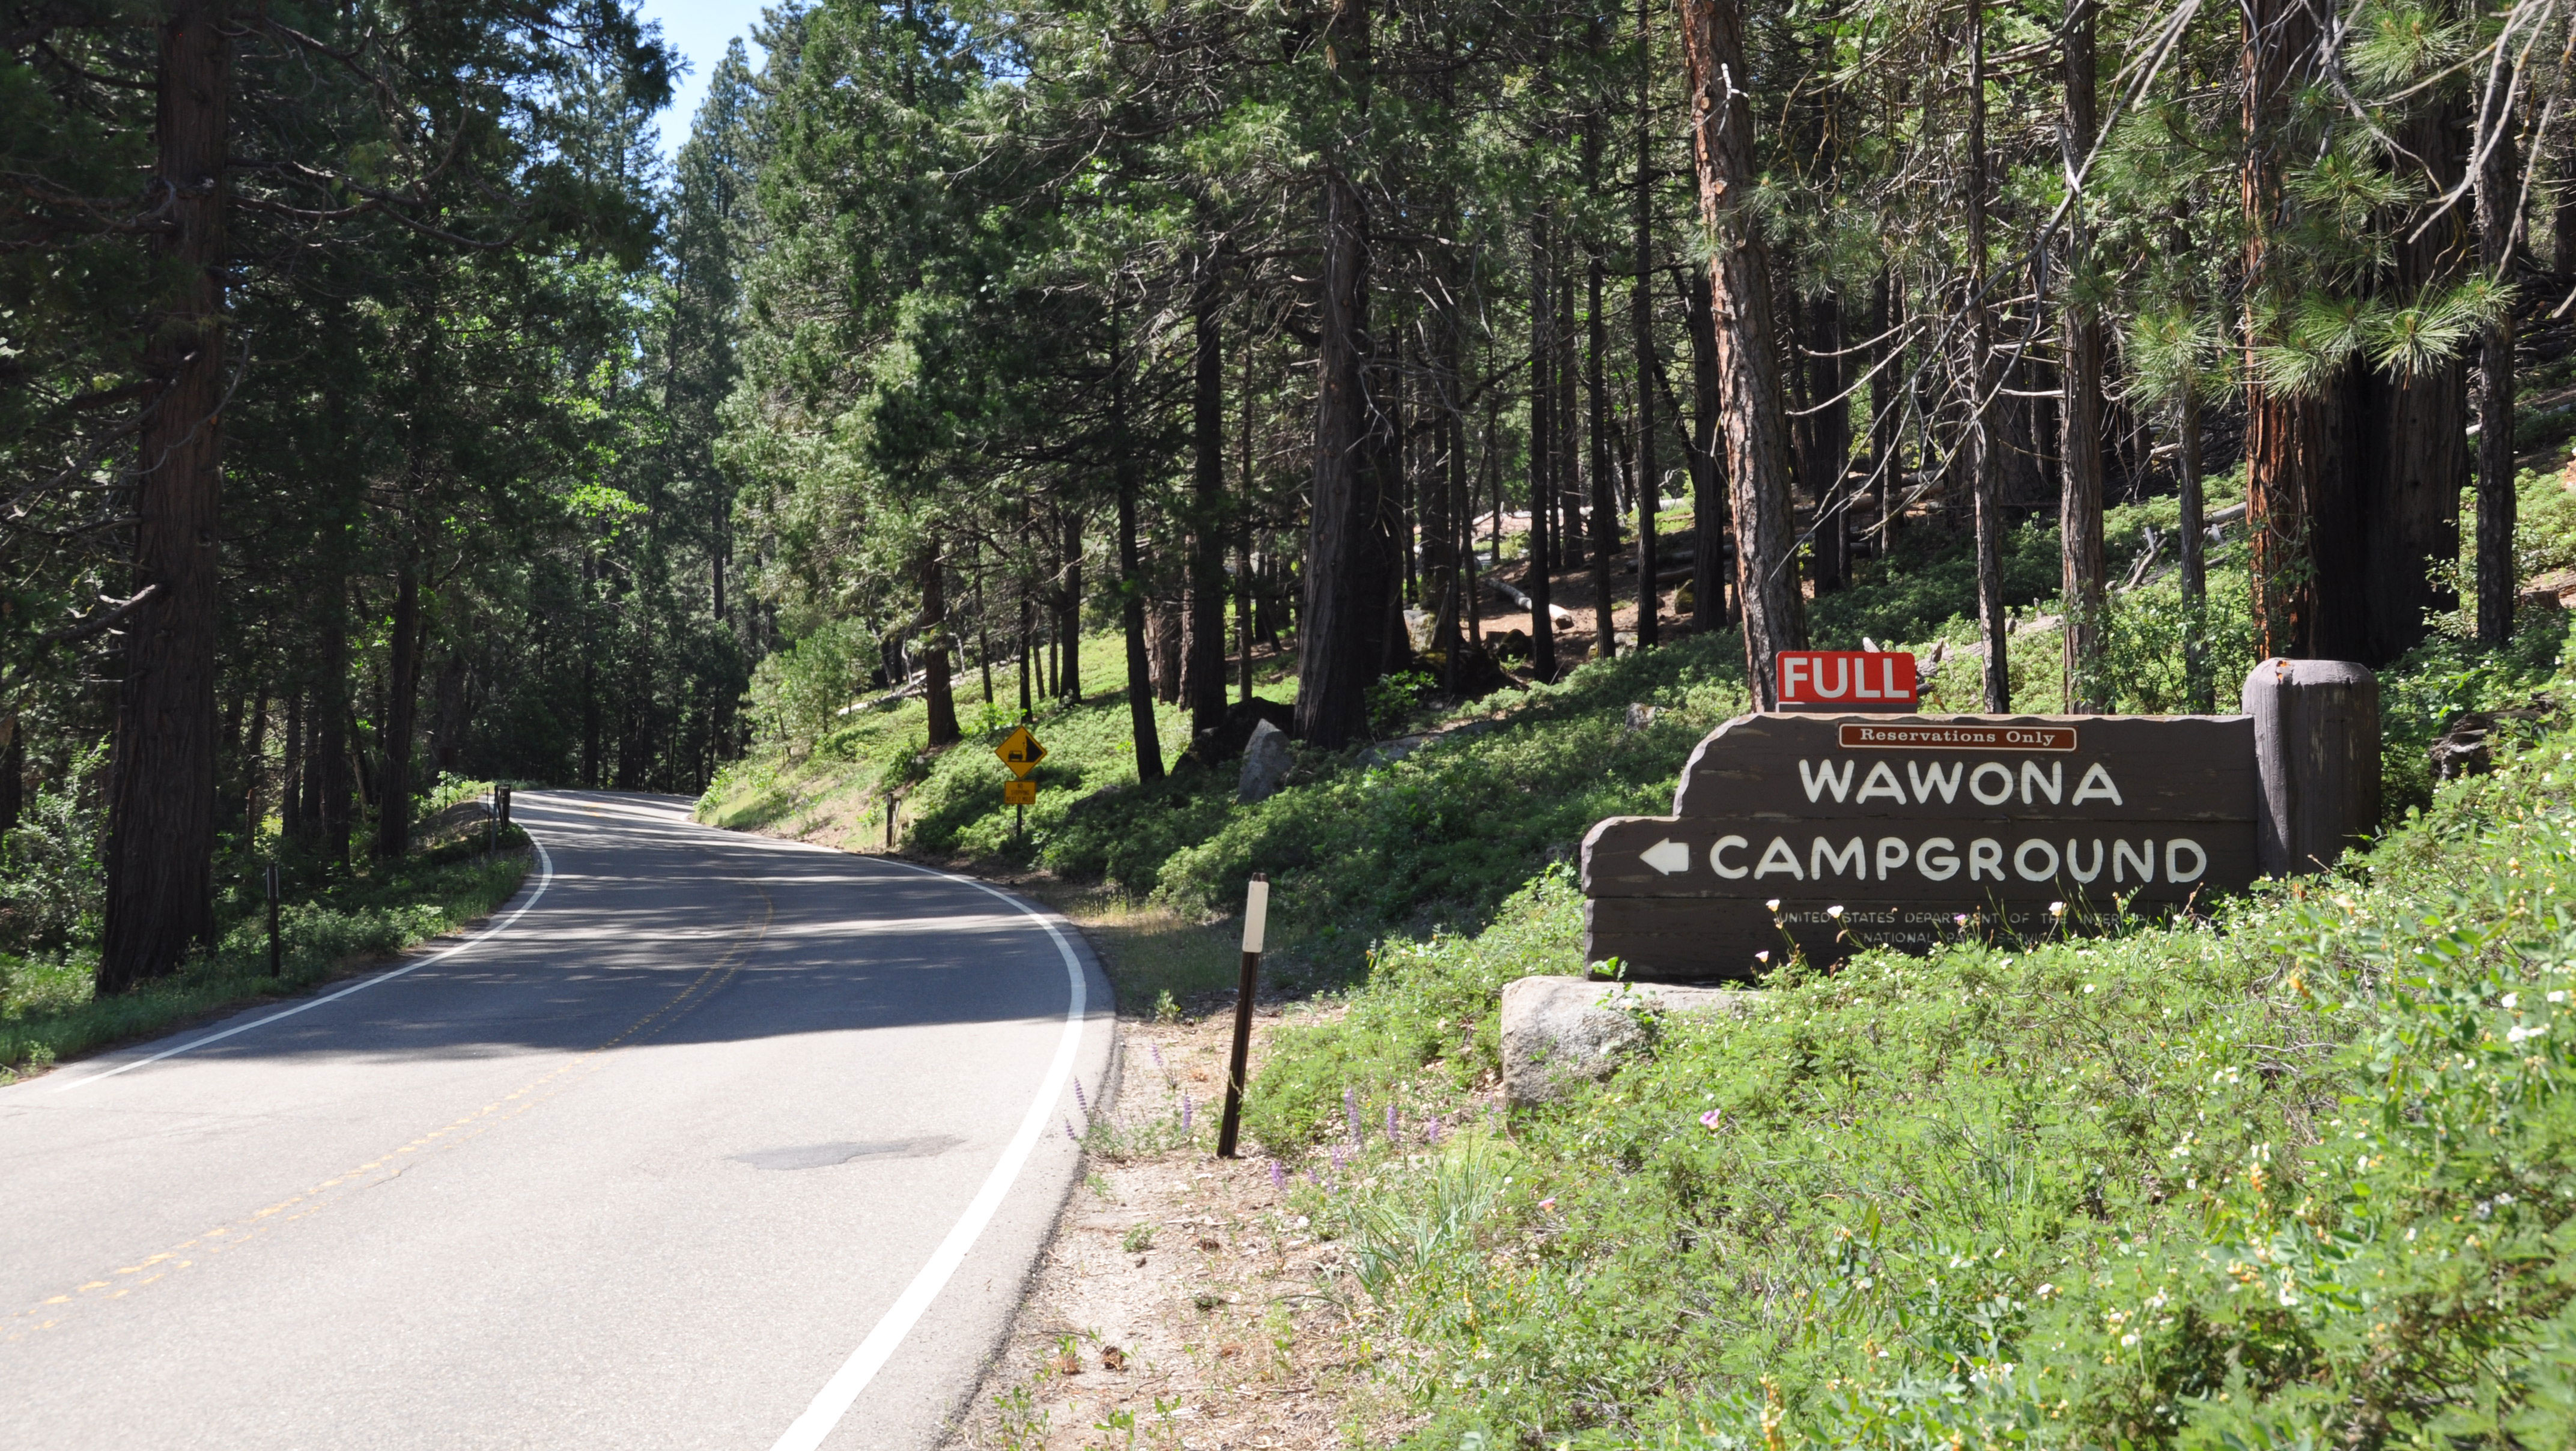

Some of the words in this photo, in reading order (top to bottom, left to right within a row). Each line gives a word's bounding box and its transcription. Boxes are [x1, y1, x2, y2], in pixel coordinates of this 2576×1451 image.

[1784, 657, 1909, 698] FULL
[1860, 728, 1996, 744] Reservations
[2006, 730, 2056, 747] Only
[1799, 759, 2123, 807] WAWONA
[1710, 835, 2208, 884] CAMPGROUND
[1779, 912, 1831, 923] UNITED
[1841, 912, 1895, 924] STATES
[2009, 913, 2030, 924] OF
[1864, 932, 1934, 944] NATIONAL
